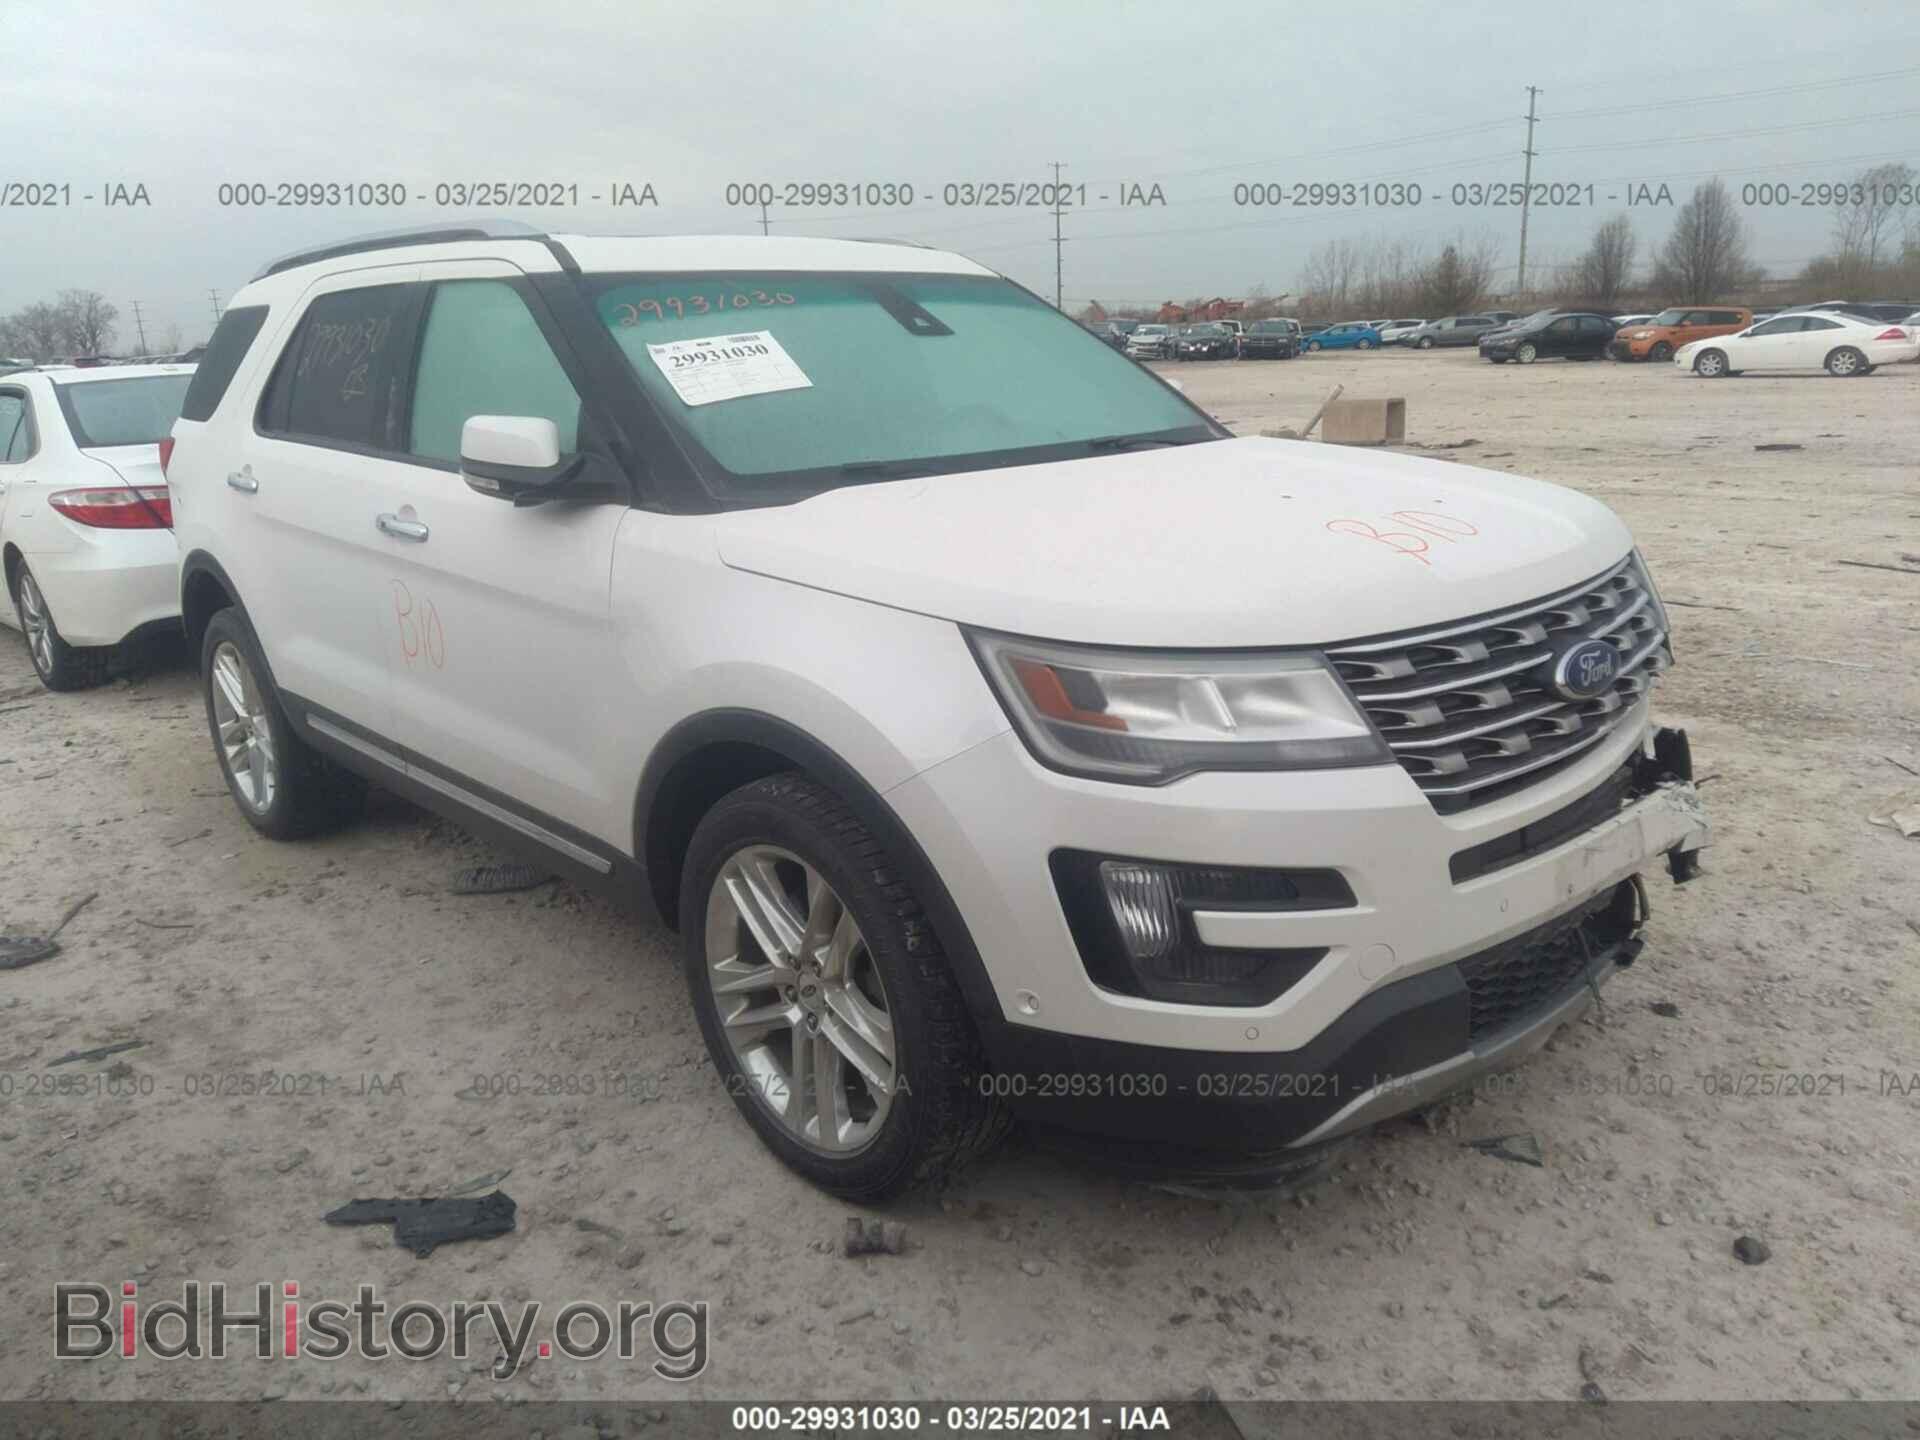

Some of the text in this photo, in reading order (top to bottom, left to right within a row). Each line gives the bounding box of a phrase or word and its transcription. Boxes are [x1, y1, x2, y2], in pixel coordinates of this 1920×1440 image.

[613, 291, 796, 326] 29931030
[669, 343, 769, 368] 29931030
[1580, 649, 1613, 686] Ford
